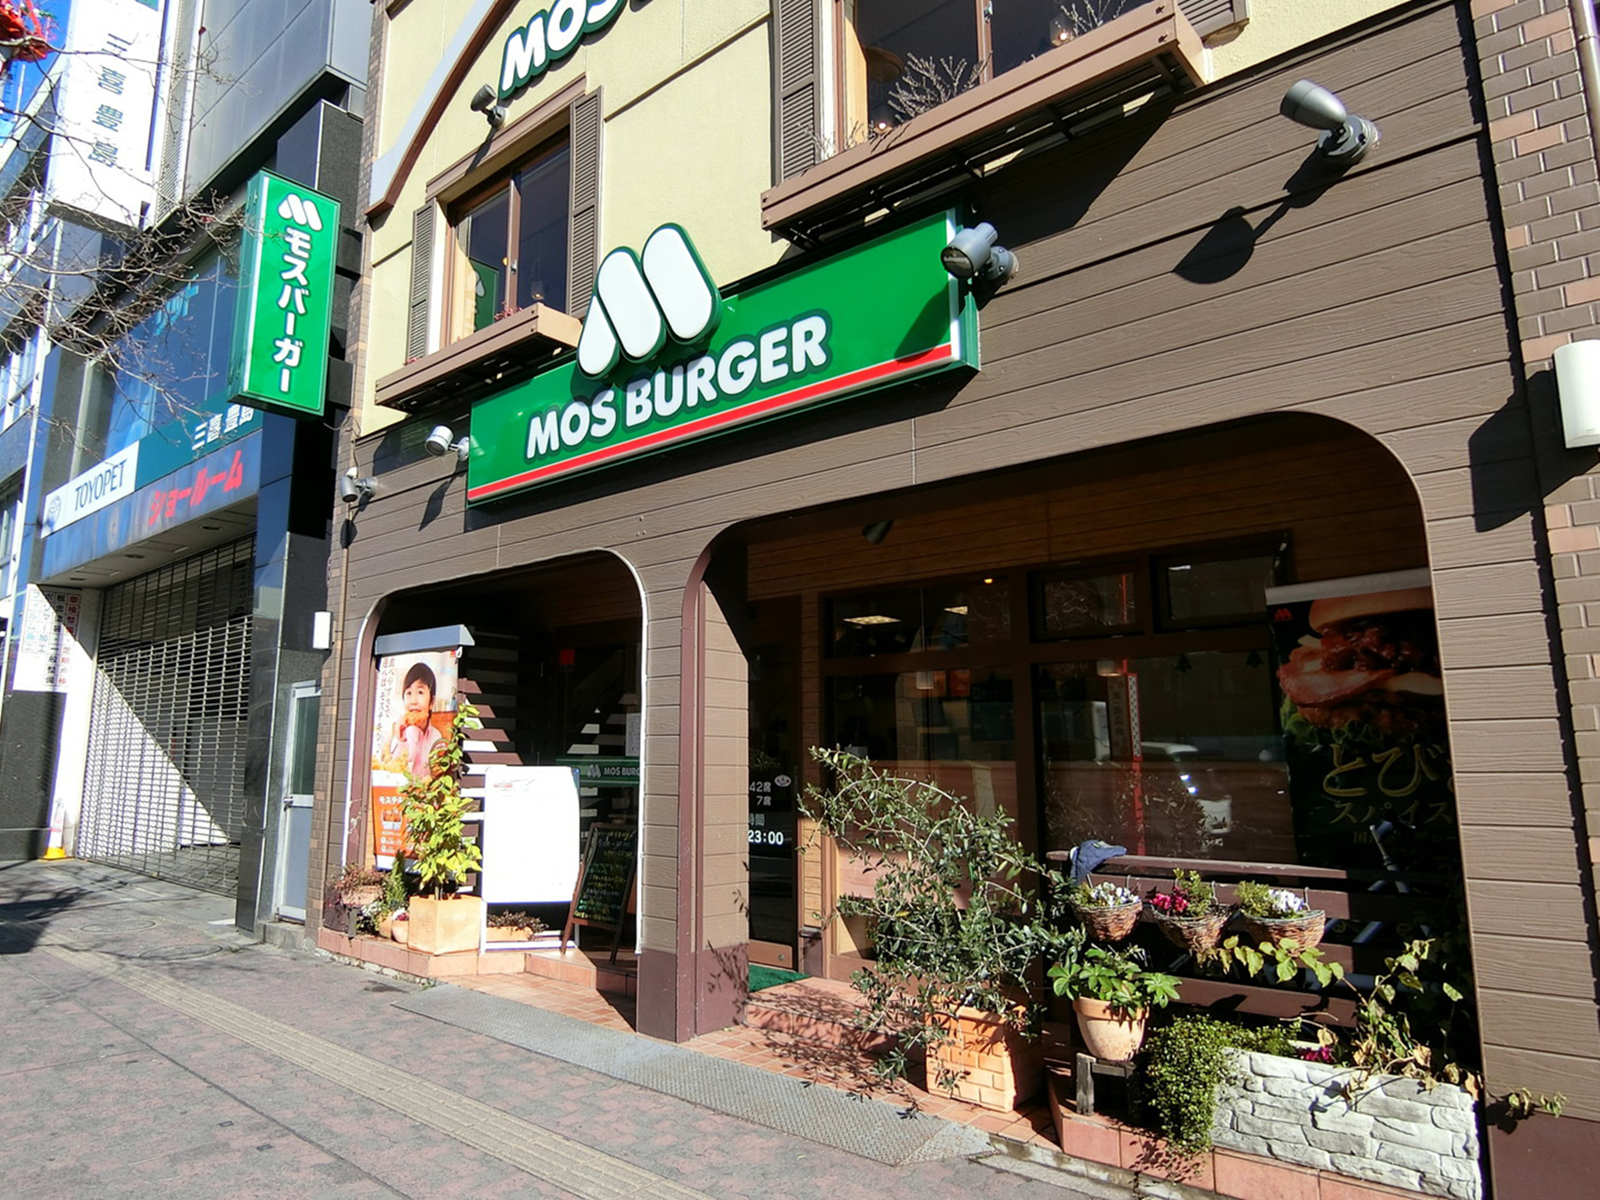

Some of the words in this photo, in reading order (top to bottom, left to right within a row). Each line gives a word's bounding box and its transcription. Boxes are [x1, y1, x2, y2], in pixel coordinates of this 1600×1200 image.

[273, 225, 312, 393] モスバーガー
[526, 390, 617, 459] MOS
[626, 316, 827, 427] BURGER
[74, 459, 128, 511] TOYOPET
[148, 450, 243, 527] ショールーム
[603, 767, 620, 776] MOS
[1323, 744, 1455, 797] とび
